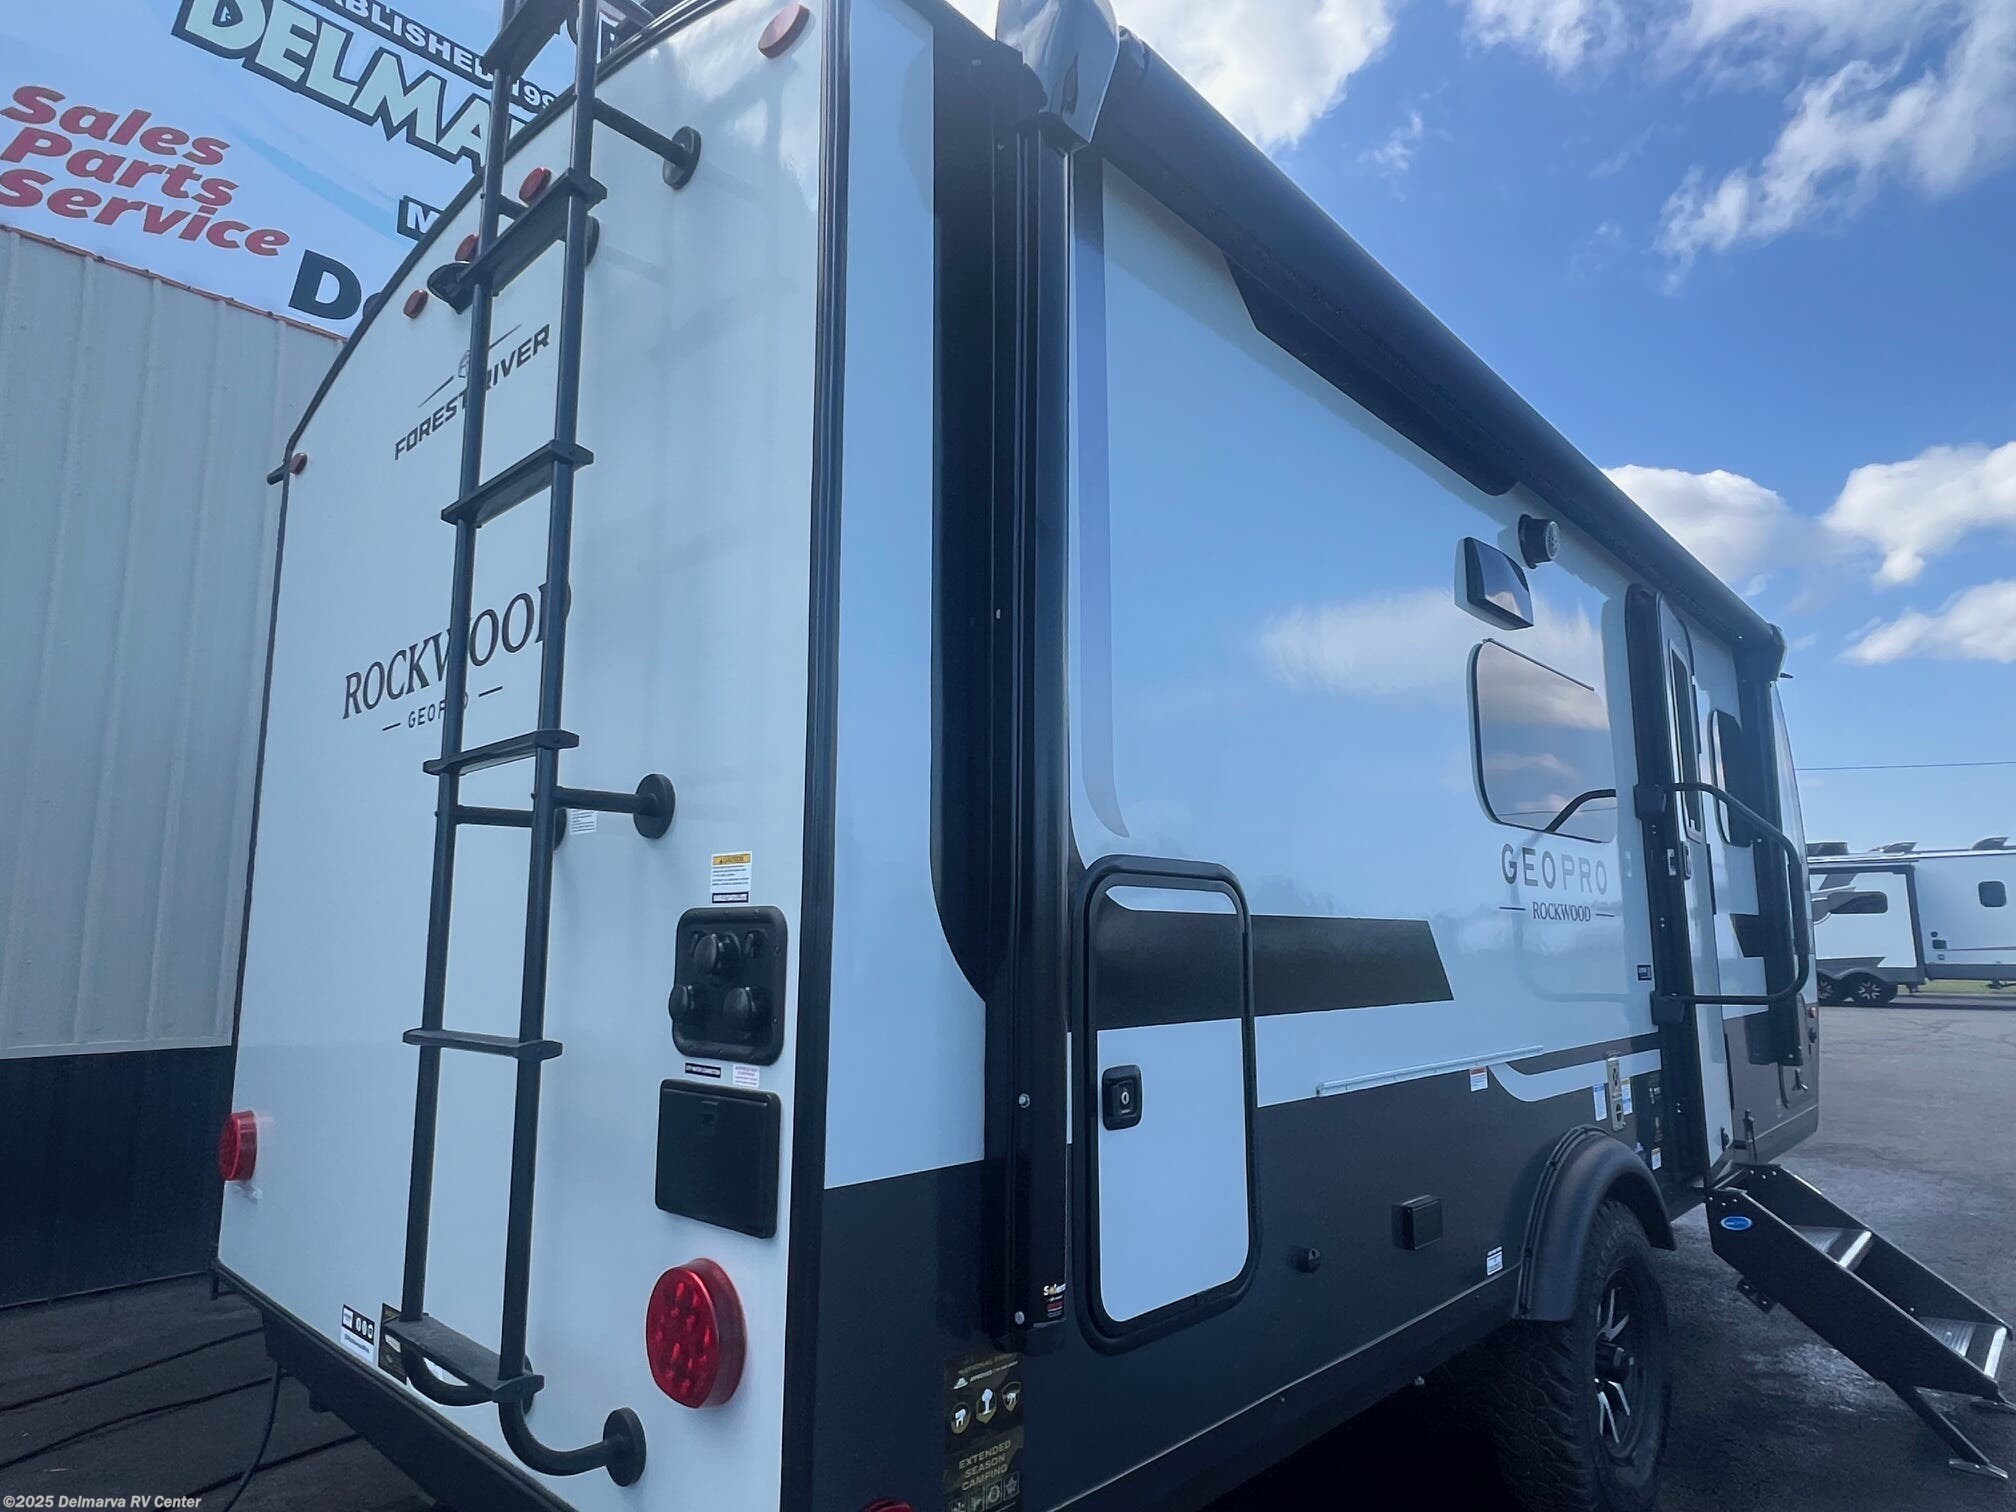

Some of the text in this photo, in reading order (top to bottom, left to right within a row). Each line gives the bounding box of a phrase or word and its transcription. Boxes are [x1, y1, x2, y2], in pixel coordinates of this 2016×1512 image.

[1, 85, 231, 166] Sales
[0, 126, 239, 207] Parts
[0, 168, 291, 257] Service
[486, 323, 550, 391] IVER
[1532, 901, 1592, 923] ROCKWOOD
[958, 1439, 1012, 1470] EXTENDED
[961, 1463, 1009, 1491] CAMPING
[964, 1453, 1006, 1479] SEASON
